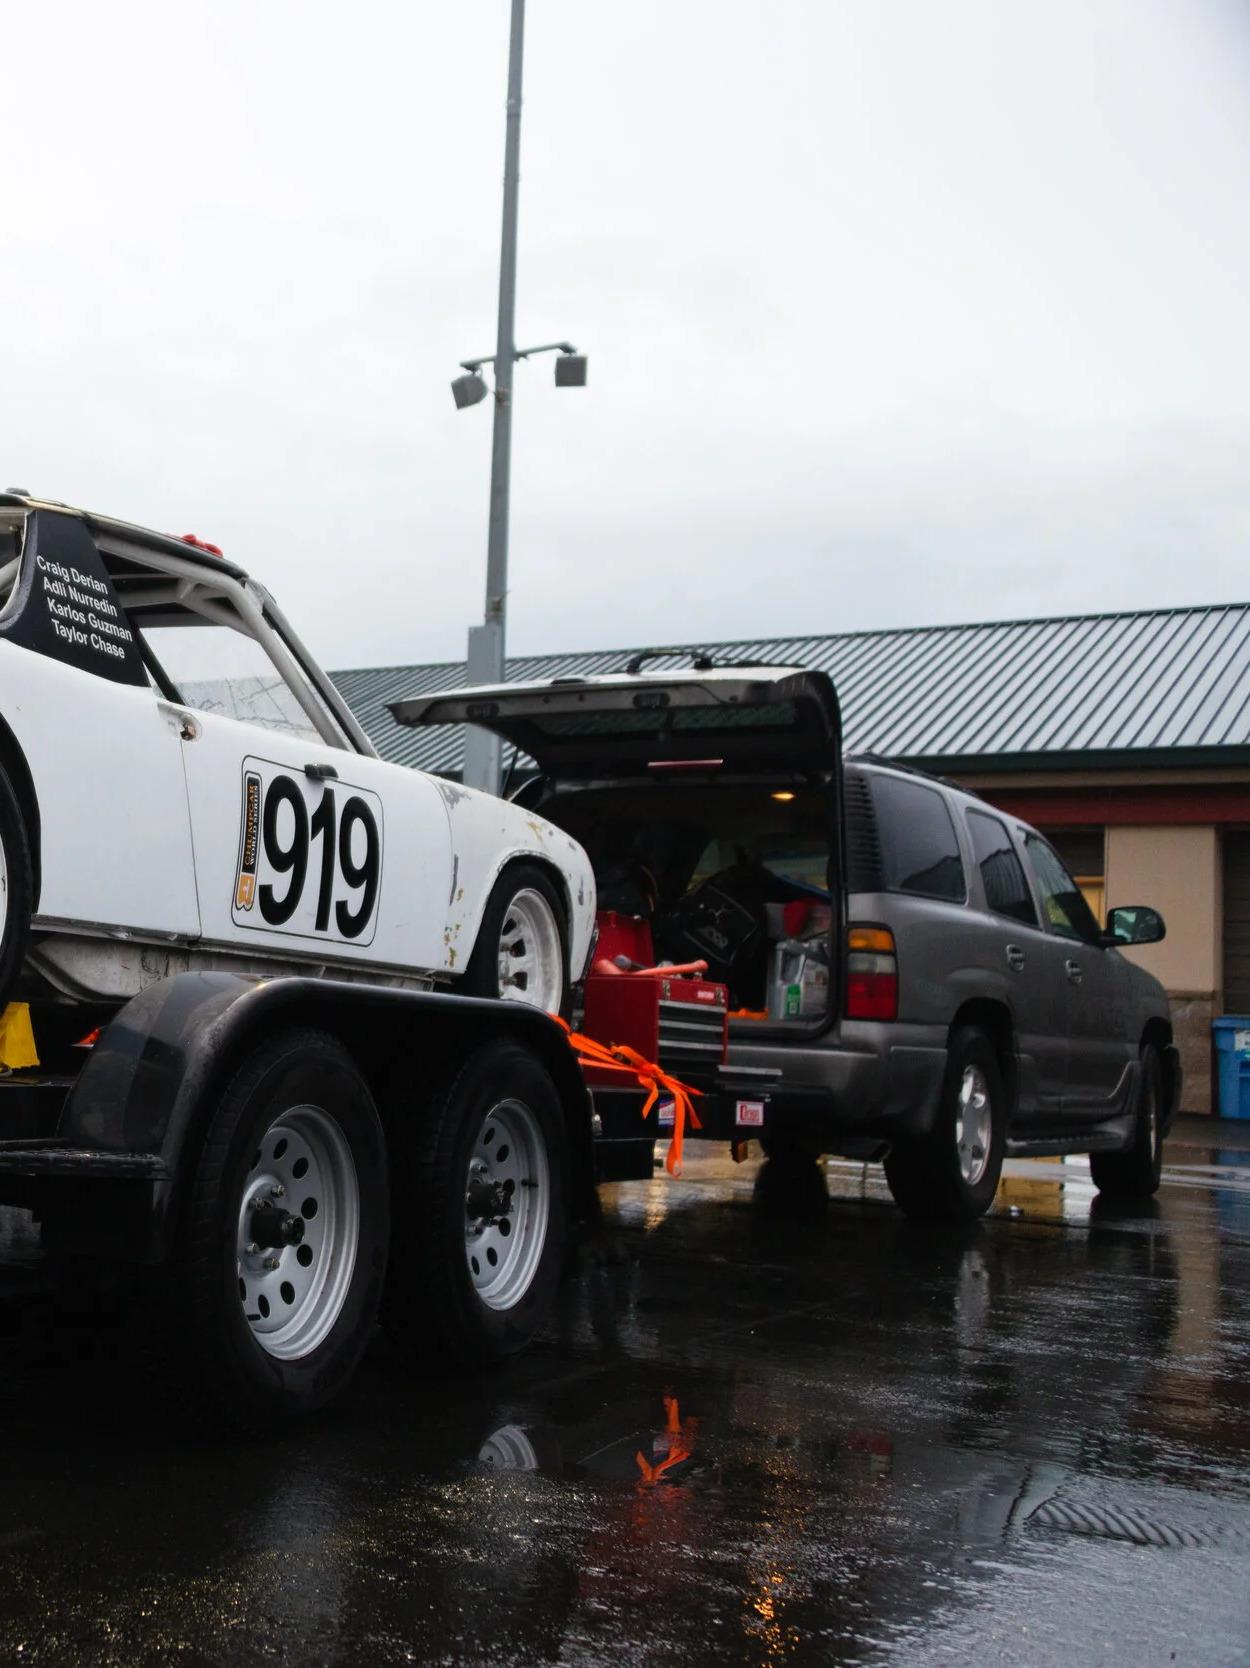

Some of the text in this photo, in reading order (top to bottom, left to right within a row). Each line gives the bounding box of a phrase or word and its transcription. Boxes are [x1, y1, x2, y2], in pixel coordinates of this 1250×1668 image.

[36, 555, 108, 594] Craig Derian
[43, 576, 118, 617] Adli Nurredin
[47, 596, 133, 642] Karlos Guzman
[51, 619, 126, 659] Taylor Chase
[245, 785, 255, 866] CHUMPCAR
[250, 825, 258, 865] WORLD
[258, 775, 380, 939] 919
